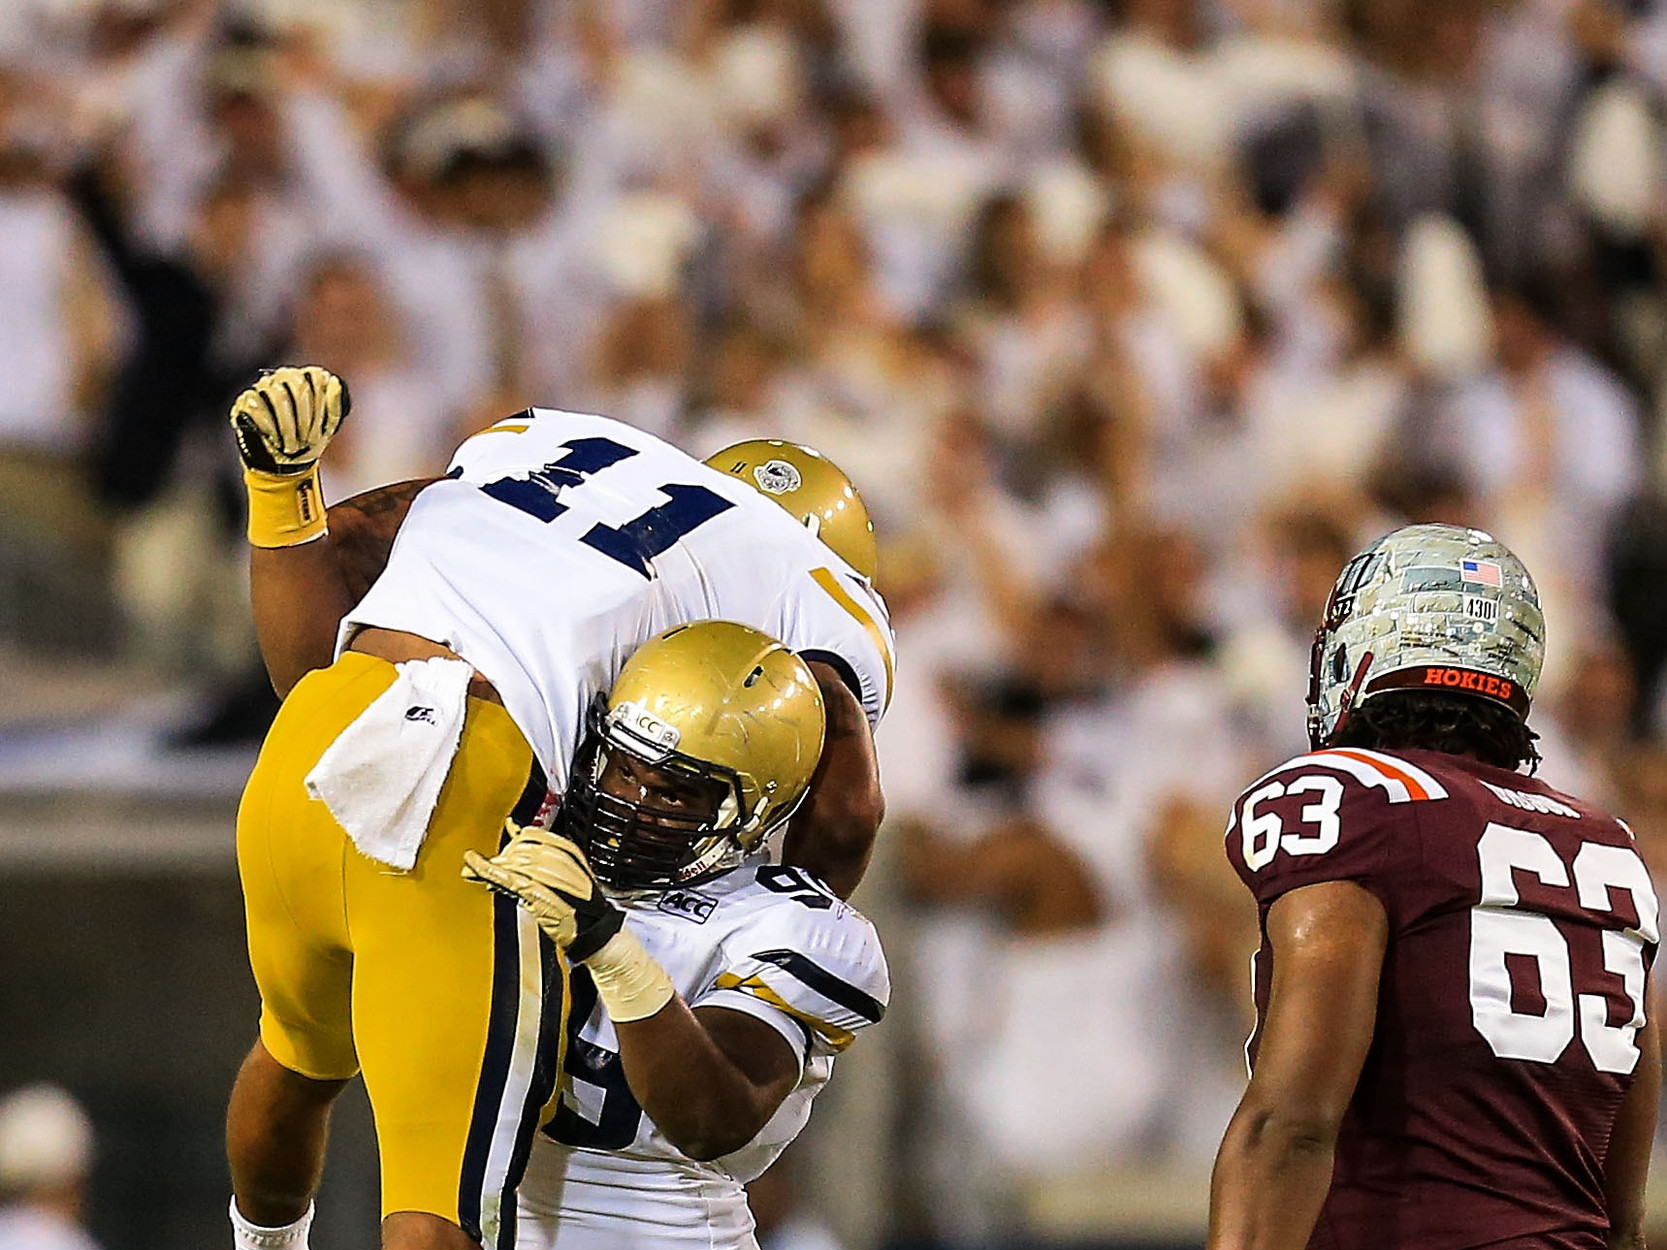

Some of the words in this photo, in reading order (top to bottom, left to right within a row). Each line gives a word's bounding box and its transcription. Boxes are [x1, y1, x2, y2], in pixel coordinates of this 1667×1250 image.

[478, 437, 738, 582] 11
[1424, 668, 1512, 699] HOKIES
[1241, 775, 1345, 873] 63
[662, 892, 715, 918] ACC
[1469, 822, 1660, 1075] 63
